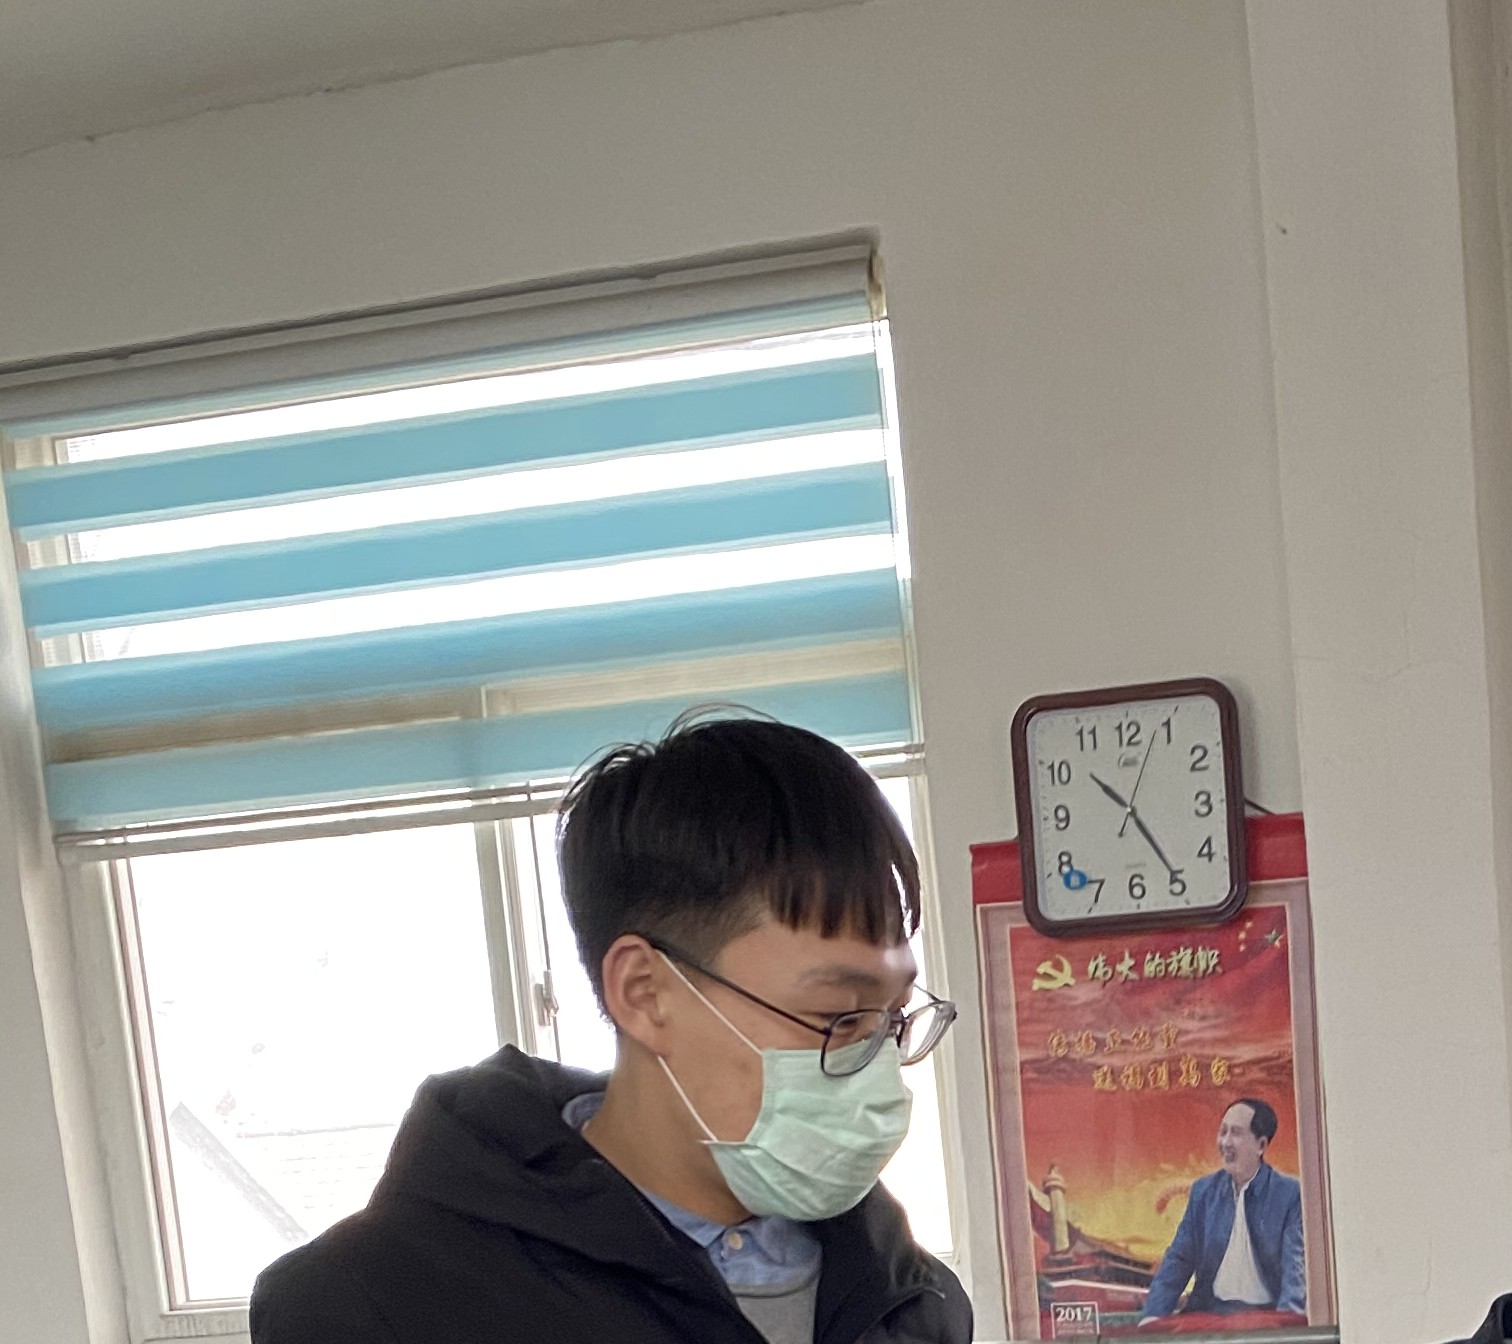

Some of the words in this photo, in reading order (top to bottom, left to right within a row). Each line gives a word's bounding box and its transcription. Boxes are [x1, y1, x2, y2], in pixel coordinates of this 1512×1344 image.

[1075, 726, 1098, 751] 11
[1114, 721, 1142, 748] 12
[1161, 717, 1173, 745] 1
[1189, 745, 1209, 772] 2
[1047, 761, 1072, 786] 10
[1053, 804, 1070, 831] 9
[1194, 791, 1213, 818] 3
[1197, 836, 1216, 863] 4
[1057, 851, 1073, 876] 8
[1087, 879, 1105, 904] 7
[1128, 874, 1146, 900] 6
[1168, 870, 1187, 896] 5
[1087, 945, 1223, 987] 伟大的旗帜
[1056, 1306, 1092, 1322] 2017
